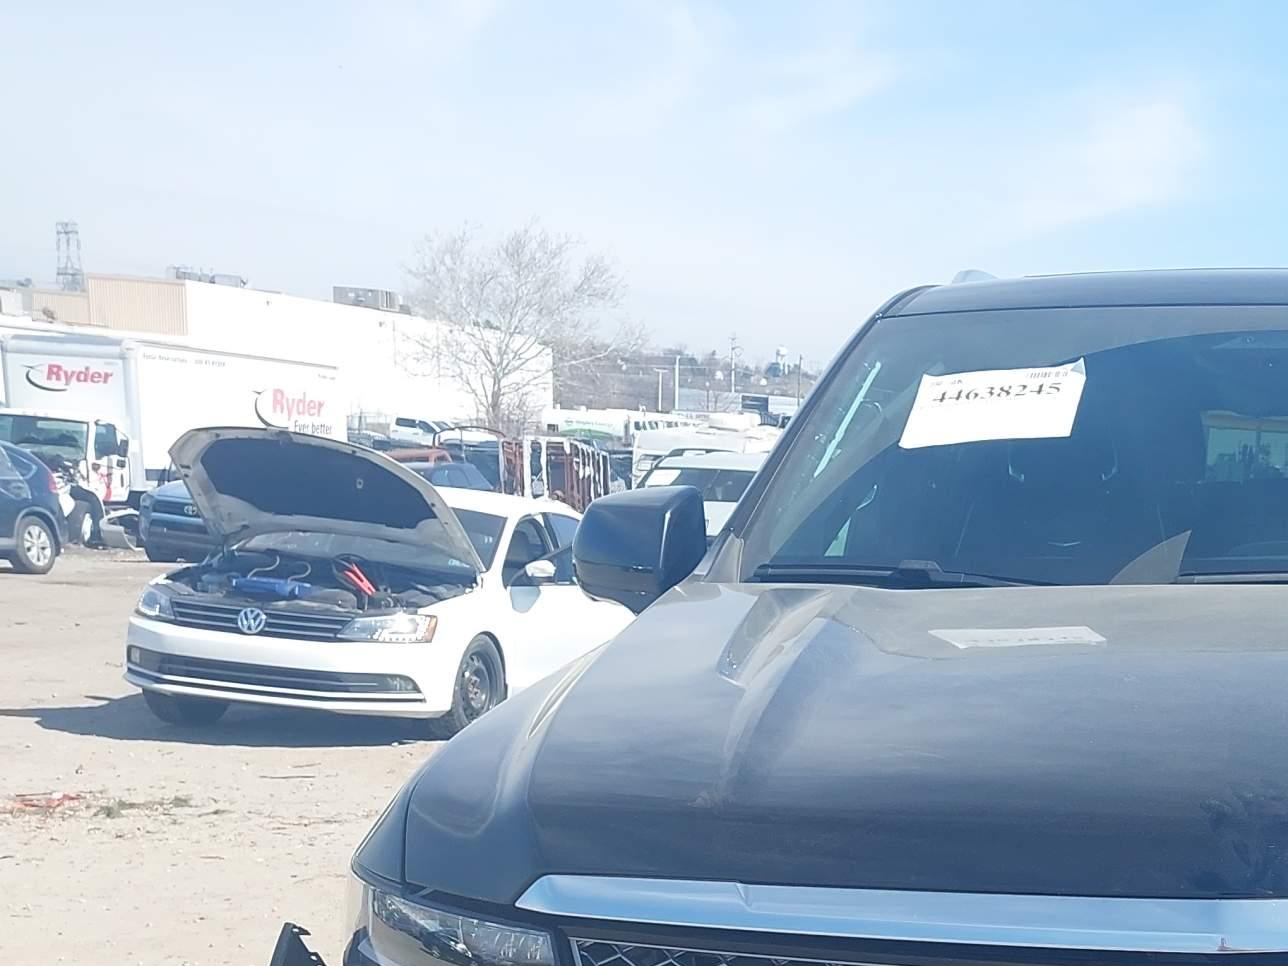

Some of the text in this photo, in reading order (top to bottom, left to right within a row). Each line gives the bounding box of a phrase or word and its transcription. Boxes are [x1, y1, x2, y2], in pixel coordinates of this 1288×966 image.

[46, 364, 114, 386] Ryder
[932, 382, 1062, 403] 44638245
[272, 388, 325, 421] Ryder
[294, 420, 333, 435] Ever better
